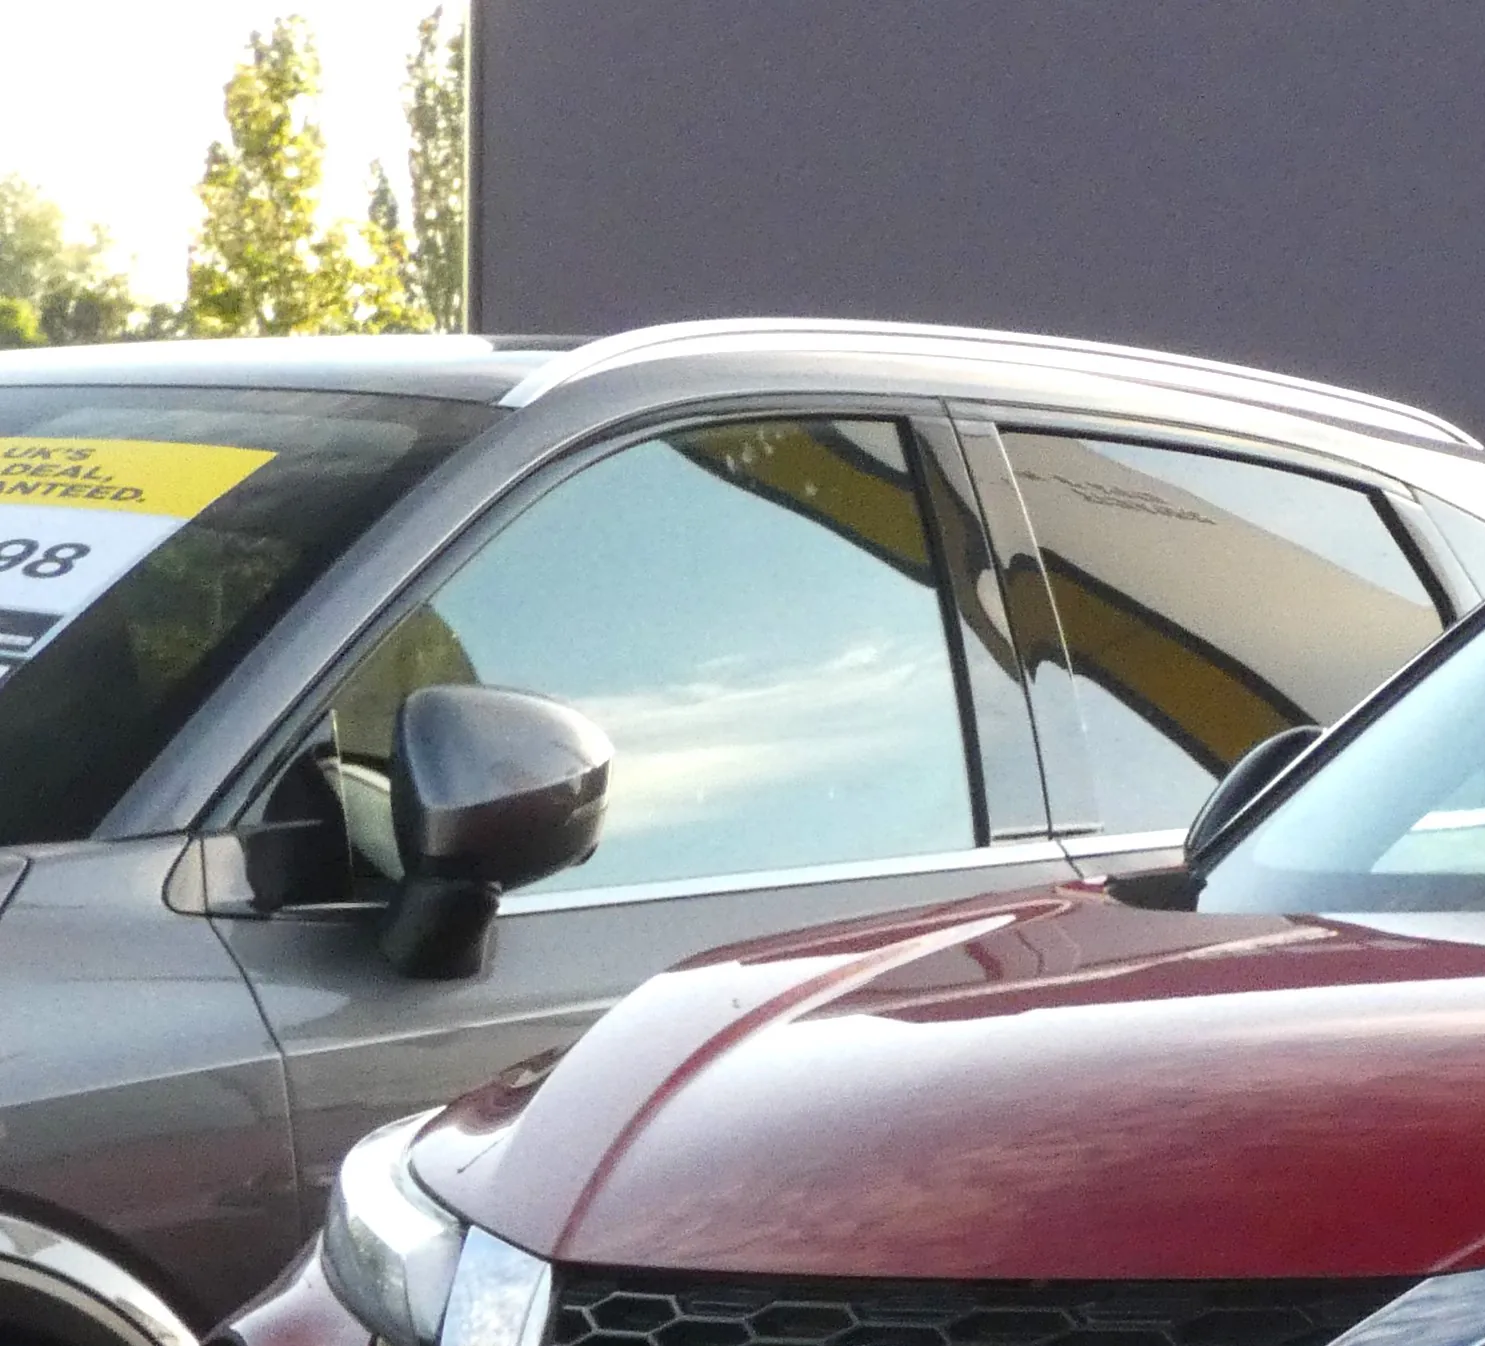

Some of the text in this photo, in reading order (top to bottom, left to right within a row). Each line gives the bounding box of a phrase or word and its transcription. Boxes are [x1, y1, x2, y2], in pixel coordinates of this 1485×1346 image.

[3, 446, 97, 461] UK'S
[0, 463, 114, 483] DEAL,
[0, 480, 146, 503] NTEED.
